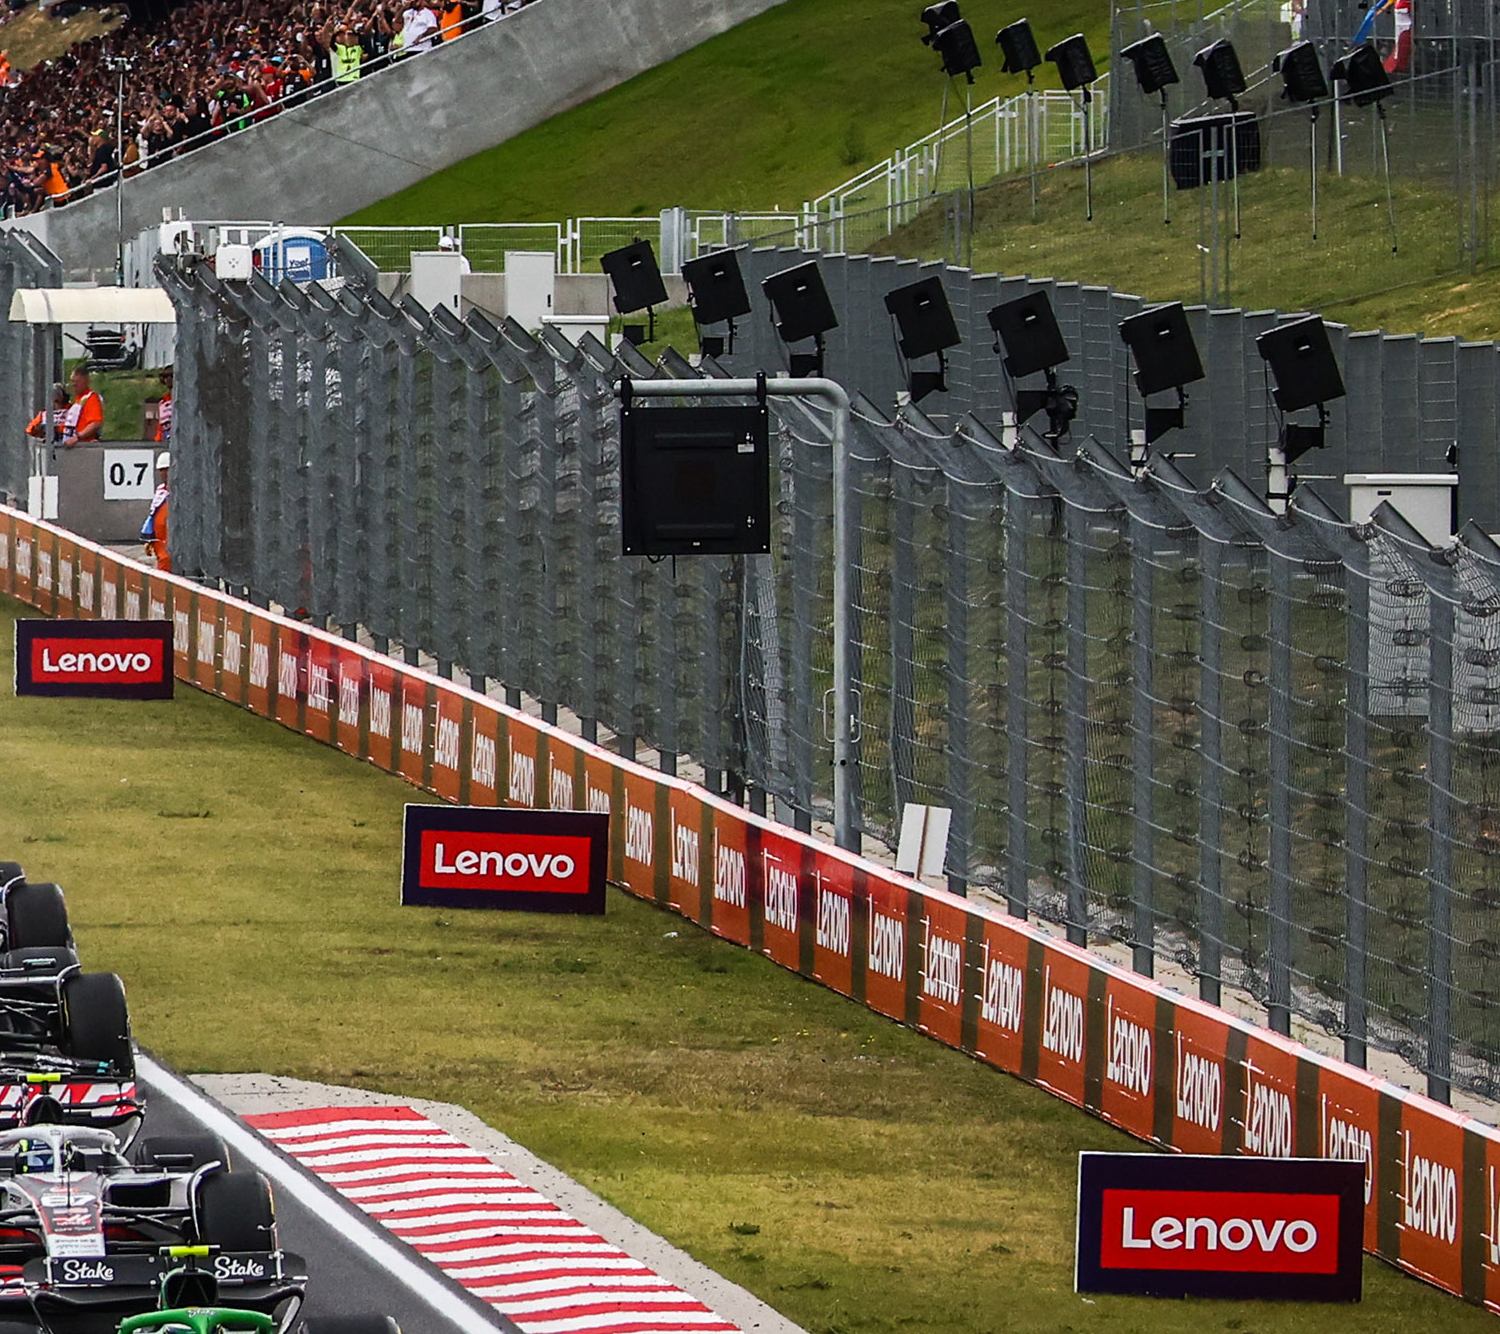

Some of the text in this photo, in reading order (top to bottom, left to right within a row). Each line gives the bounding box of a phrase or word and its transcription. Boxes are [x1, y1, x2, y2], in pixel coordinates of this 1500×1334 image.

[109, 462, 148, 488] 0.7
[42, 646, 151, 673] Lenovo
[434, 842, 575, 879] Lenovo
[625, 787, 652, 867] Lenovo
[671, 806, 700, 887] Lenovo
[714, 827, 746, 908] Lenovo
[764, 847, 798, 933] Lenovo
[816, 870, 850, 958] Lenovo
[868, 894, 903, 981] Lenovo
[923, 915, 961, 1006] Lenovo
[981, 938, 1023, 1033] Lenovo
[1043, 965, 1085, 1064] Lenovo
[1106, 993, 1152, 1098] Lenovo
[1174, 1030, 1222, 1132] Lenovo
[1244, 1058, 1292, 1156] Lenovo
[1121, 1206, 1318, 1254] Lenovo
[1404, 1130, 1457, 1244] Lenovo
[63, 1259, 114, 1281] Stake
[214, 1256, 264, 1279] Stake
